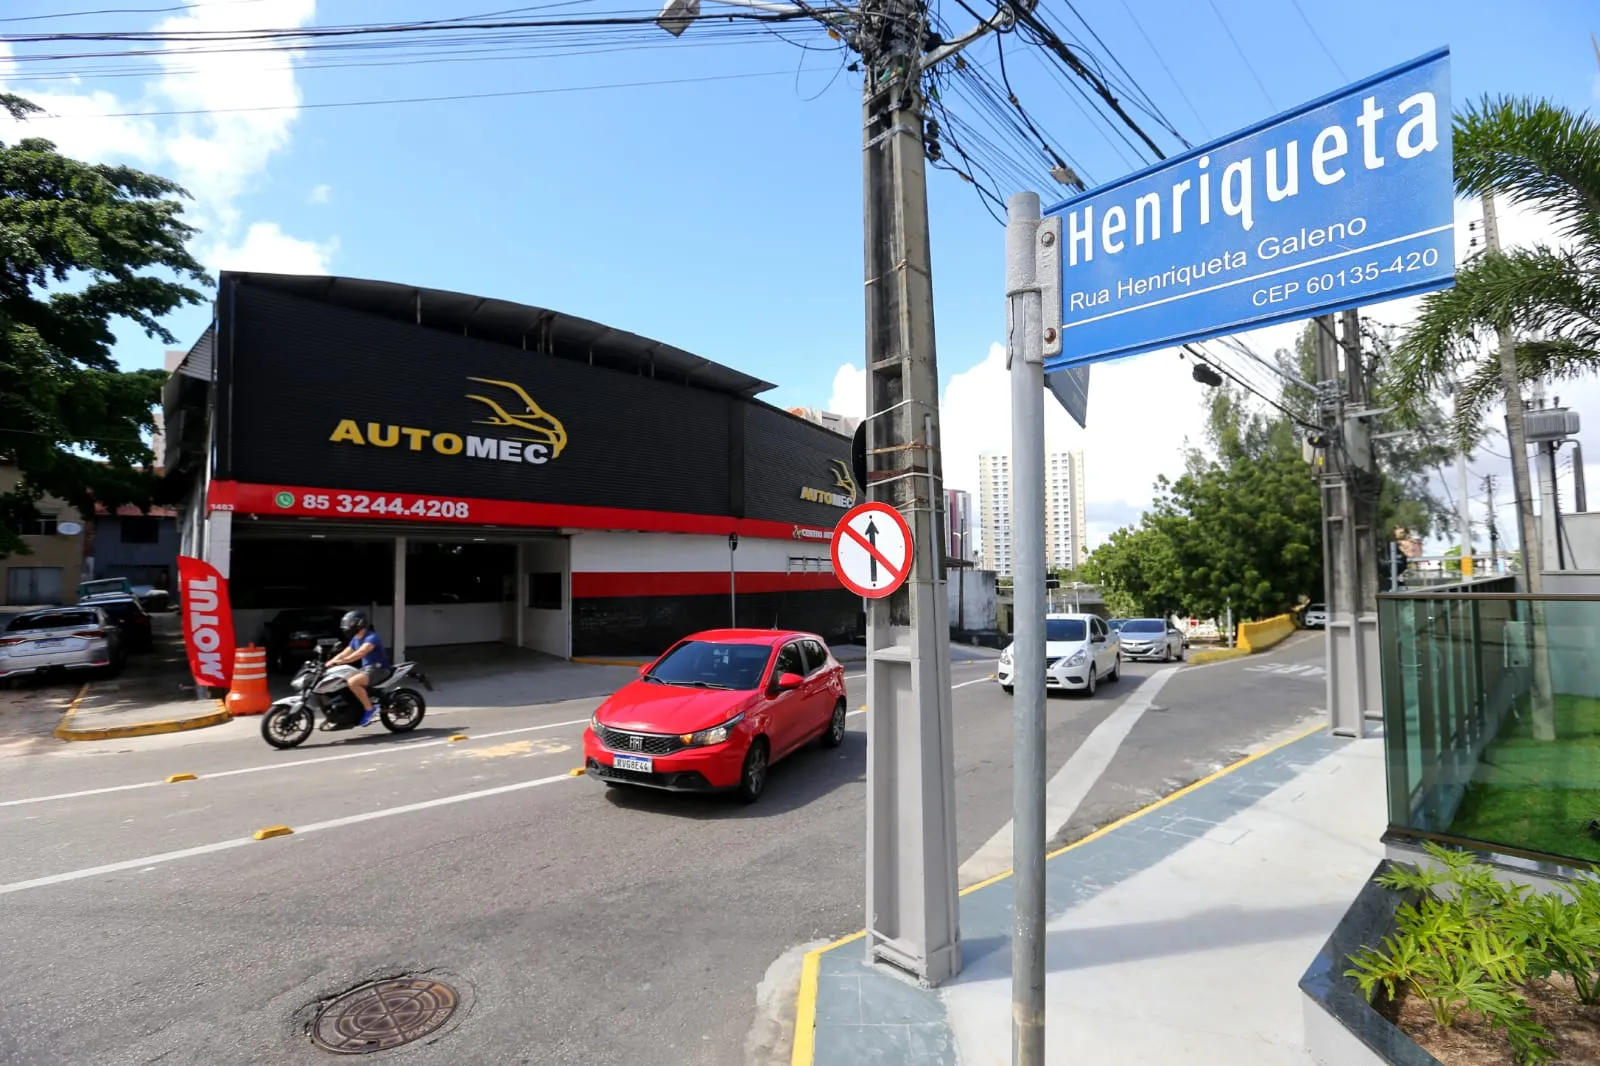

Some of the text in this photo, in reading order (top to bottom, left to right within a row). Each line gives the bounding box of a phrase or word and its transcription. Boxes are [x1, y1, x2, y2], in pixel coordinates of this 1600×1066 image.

[1068, 91, 1439, 267] Henriqueta
[1070, 217, 1367, 311] Rua Henriqueta Galeno
[1252, 248, 1439, 306] CEP 60135-420
[329, 419, 549, 465] AUTOMEC
[303, 493, 469, 518] 85 3244.4208
[800, 486, 854, 508] AUTOMEC
[188, 575, 224, 680] MOTUL
